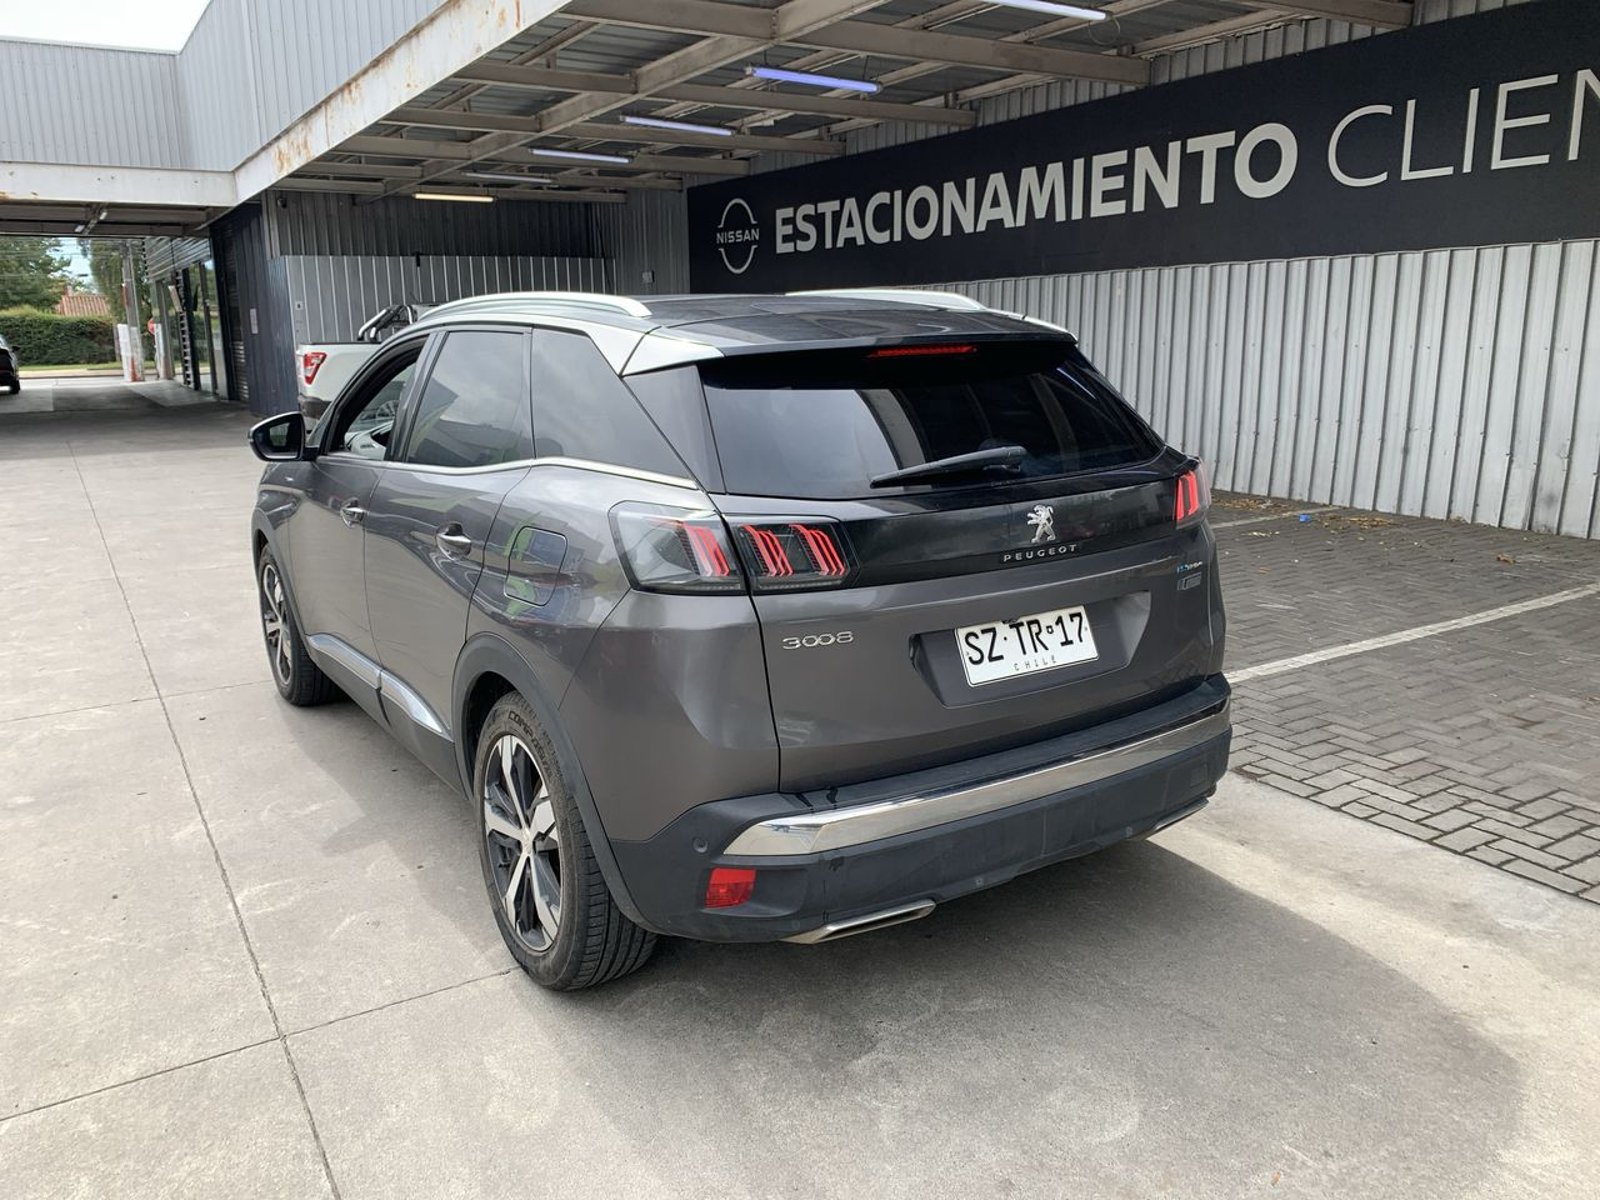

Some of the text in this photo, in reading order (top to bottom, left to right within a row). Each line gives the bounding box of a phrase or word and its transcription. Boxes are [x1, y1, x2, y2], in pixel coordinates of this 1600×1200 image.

[775, 122, 1299, 254] ESTACIONAMIENTO
[716, 228, 760, 245] NISSAN
[1003, 544, 1077, 562] PEUGEOT
[782, 631, 854, 650] 3008
[1013, 654, 1058, 672] CHILE
